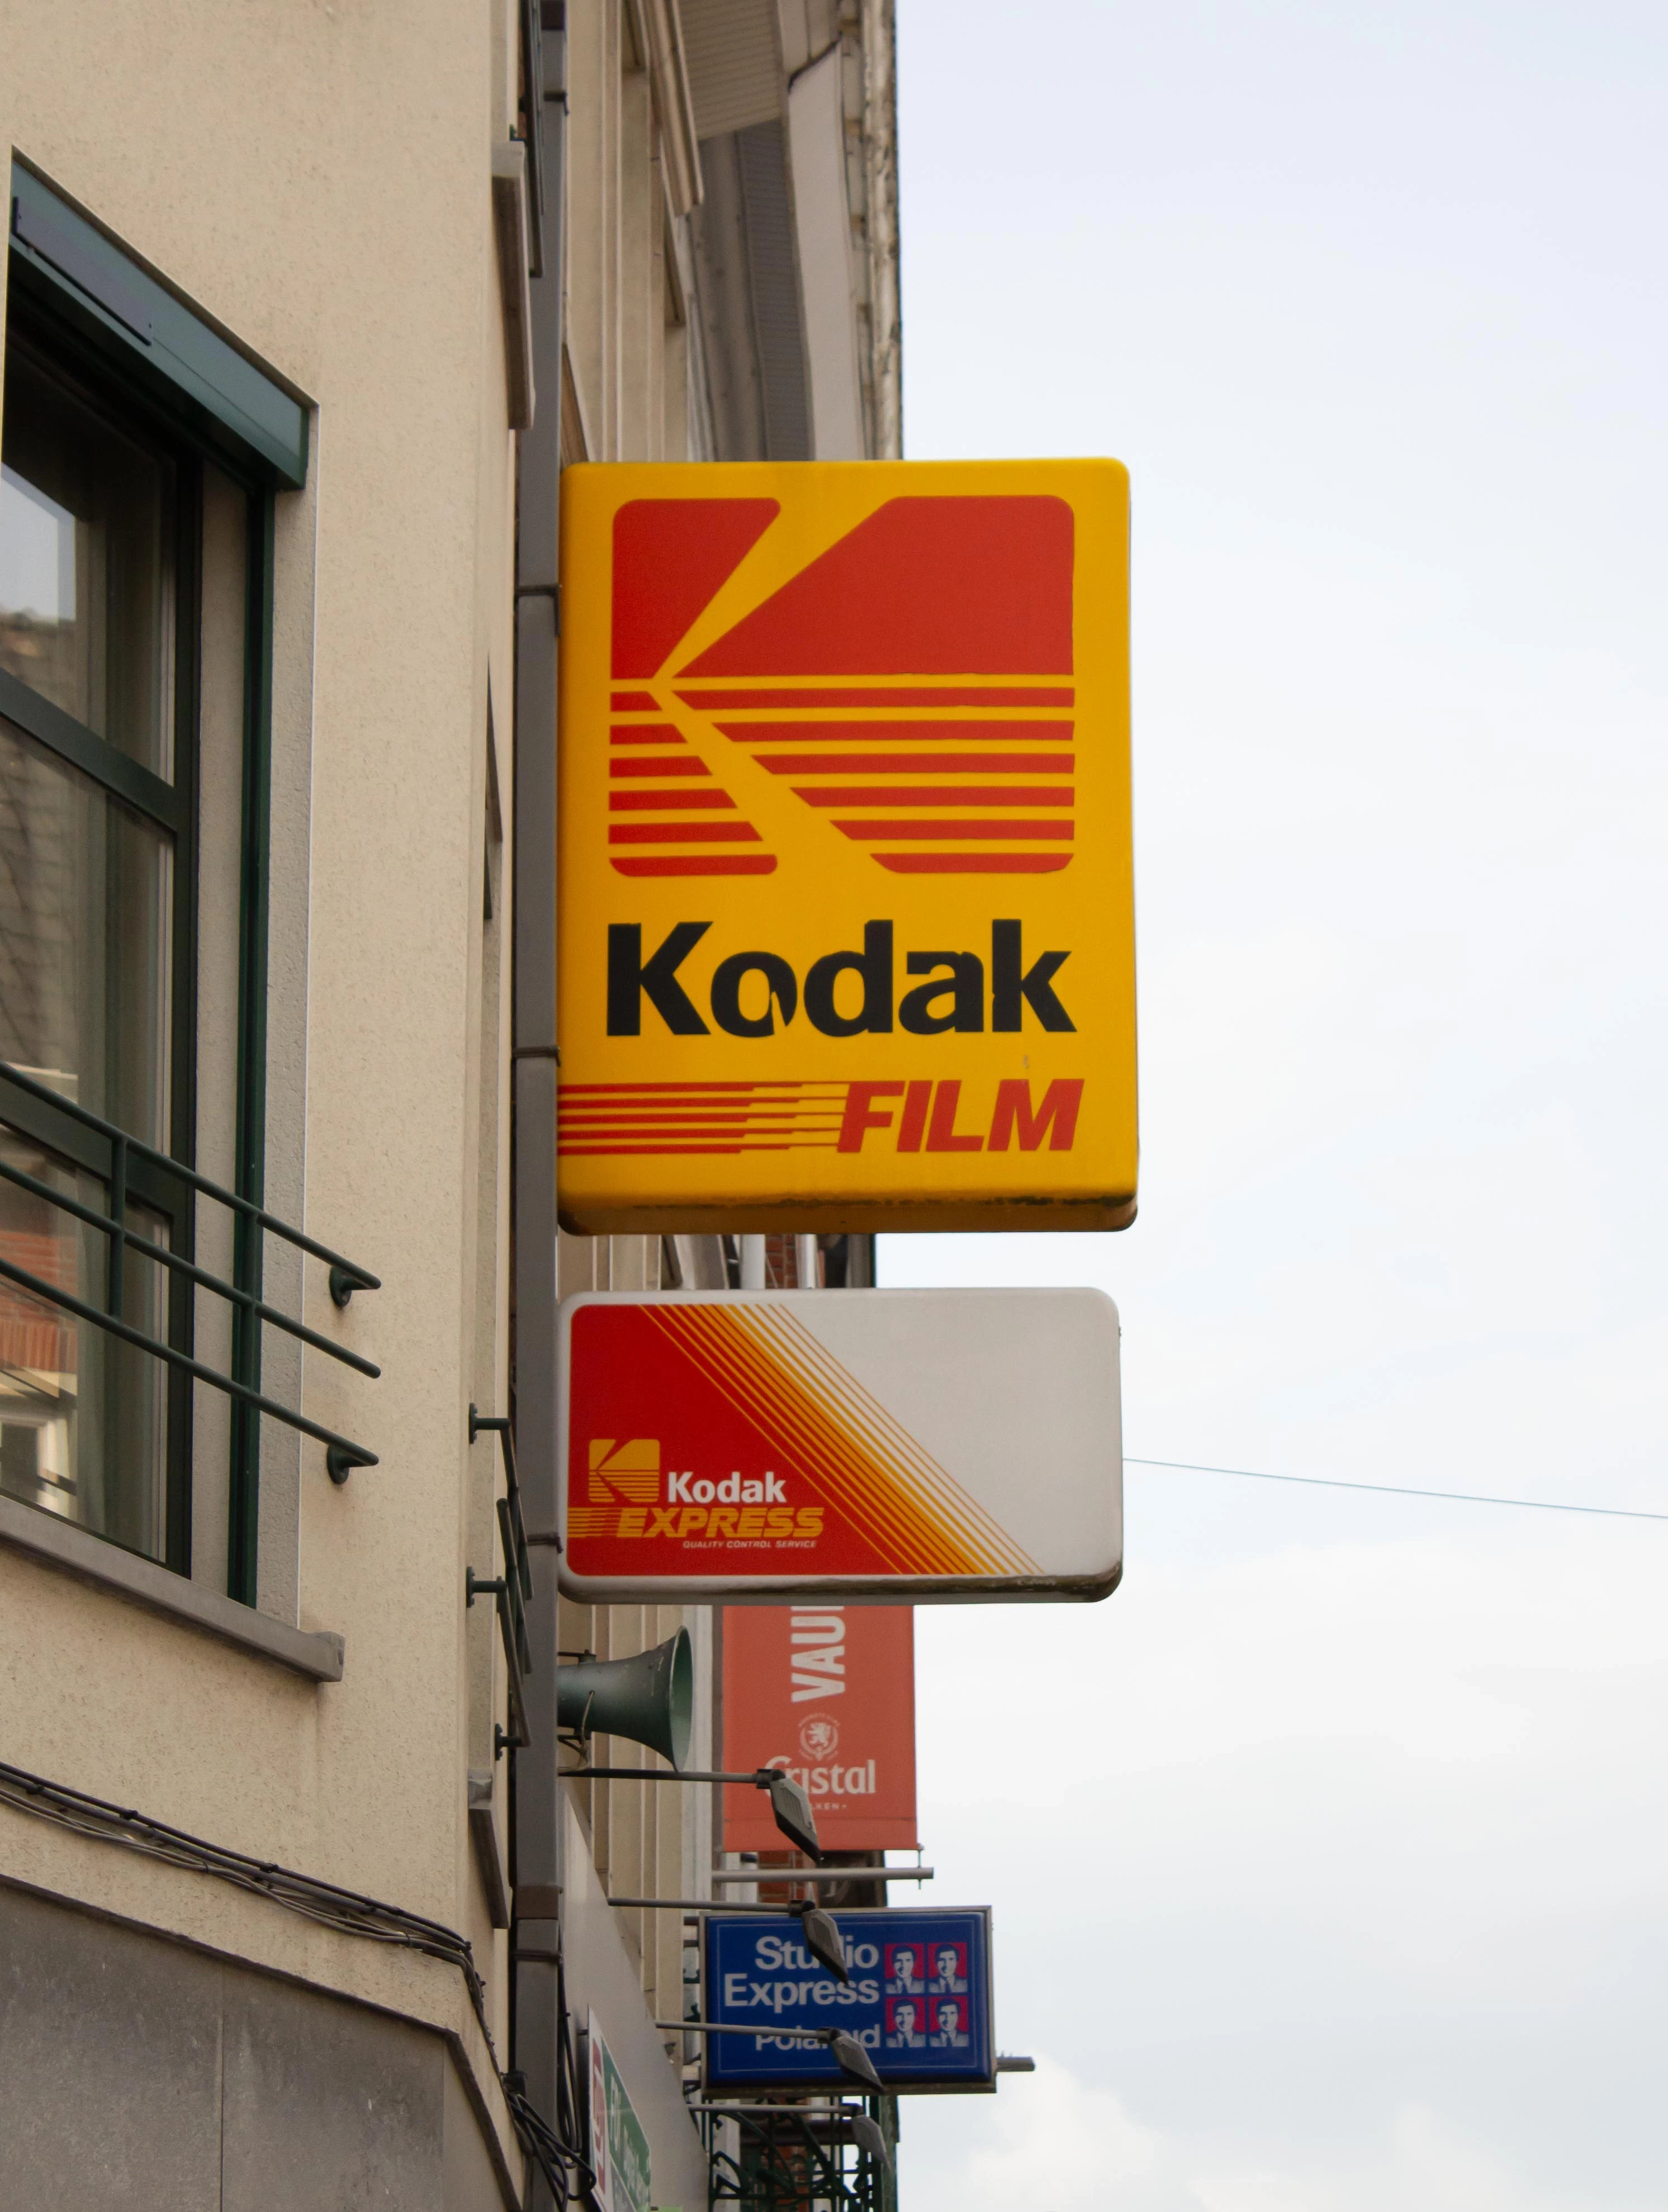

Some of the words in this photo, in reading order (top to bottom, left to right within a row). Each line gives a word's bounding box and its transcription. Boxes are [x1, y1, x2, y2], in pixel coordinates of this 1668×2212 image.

[607, 920, 1077, 1037] Kodak
[837, 1078, 1084, 1153] FILM
[668, 1471, 786, 1503] Kodak
[617, 1508, 824, 1538] EXPRESS
[683, 1540, 724, 1549] QUALITY
[727, 1540, 771, 1548] CONTROL
[775, 1540, 817, 1548] SERVICE
[755, 1935, 879, 1971] Stuio
[724, 1973, 879, 2014] Express
[756, 2024, 881, 2051] Polaid
